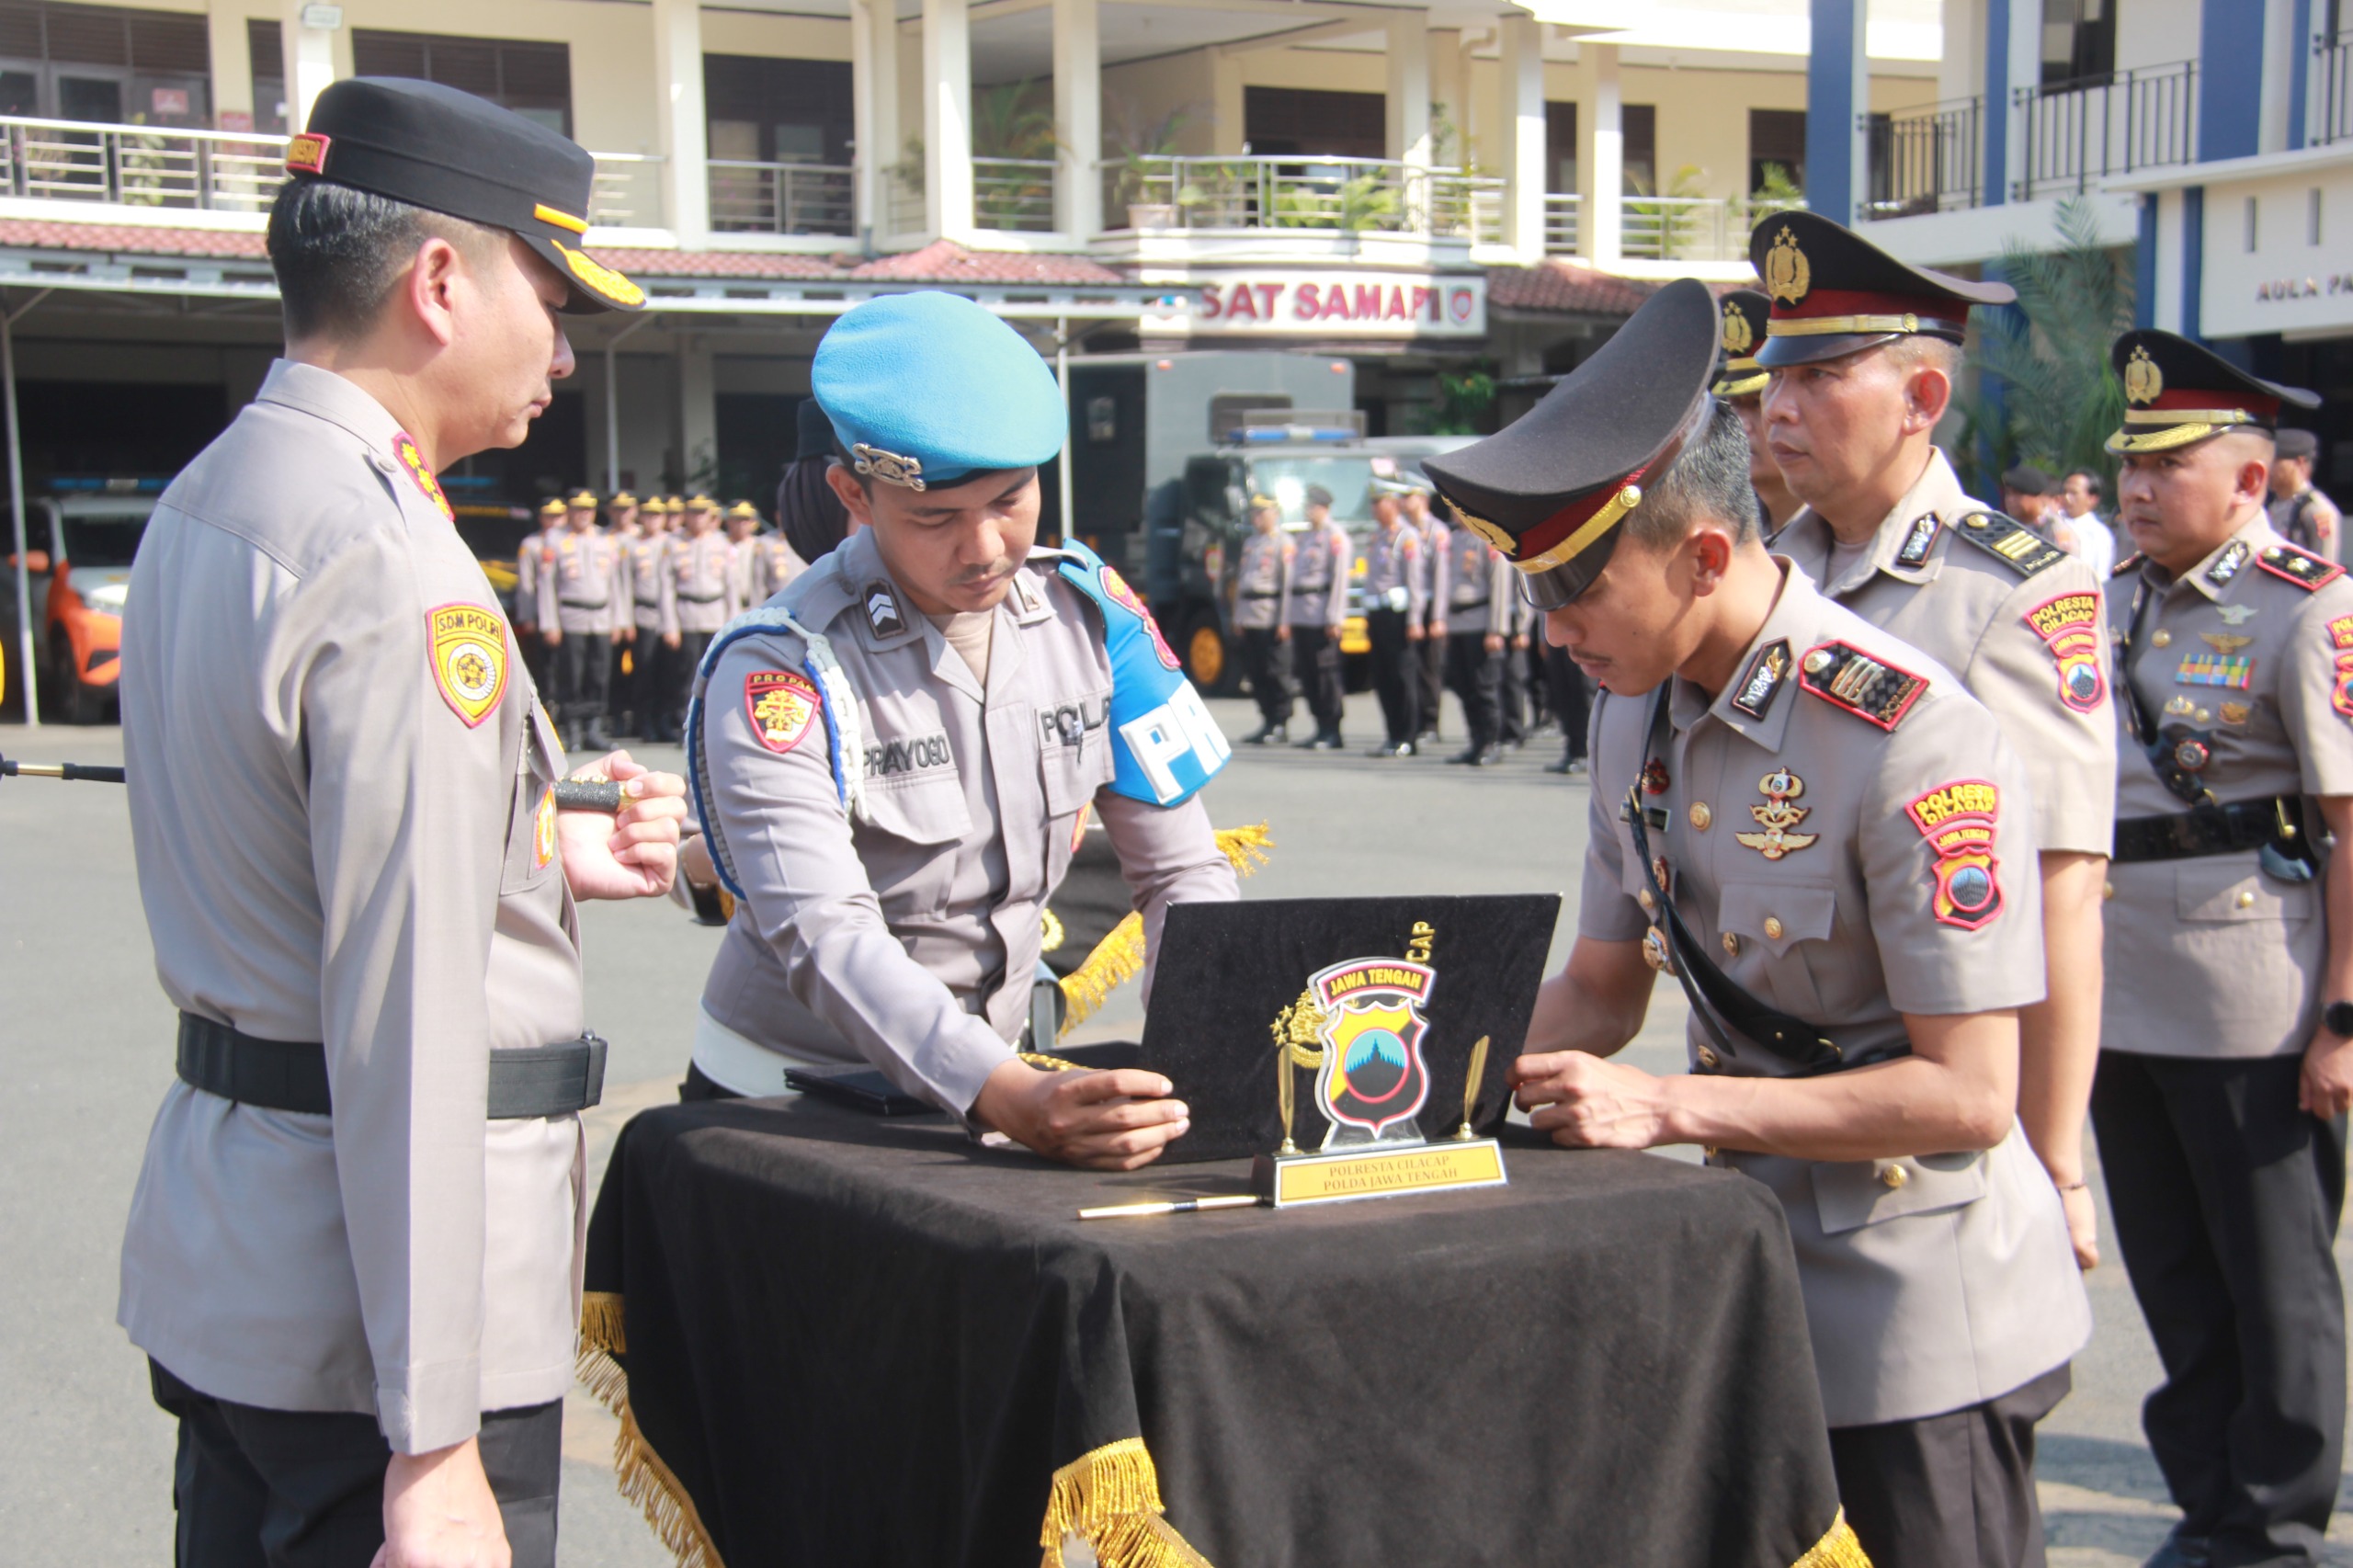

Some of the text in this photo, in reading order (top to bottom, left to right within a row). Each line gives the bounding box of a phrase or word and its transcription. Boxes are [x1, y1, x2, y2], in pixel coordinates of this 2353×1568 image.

[1202, 281, 1285, 321] SAT
[2256, 275, 2318, 302] AULA
[2031, 596, 2095, 627] POLRESTA
[2041, 610, 2094, 634] CILACAP
[438, 612, 500, 640] SDM POLRI
[1915, 784, 1995, 820] POLRESTA
[1926, 799, 1994, 825] CILACAP
[1405, 921, 1436, 963] CAP
[1330, 968, 1422, 996] JAWA TENGAH
[1324, 1168, 1458, 1191] POLDA JAWA TENGAH
[1329, 1154, 1450, 1177] POLRESTA CILACAP
